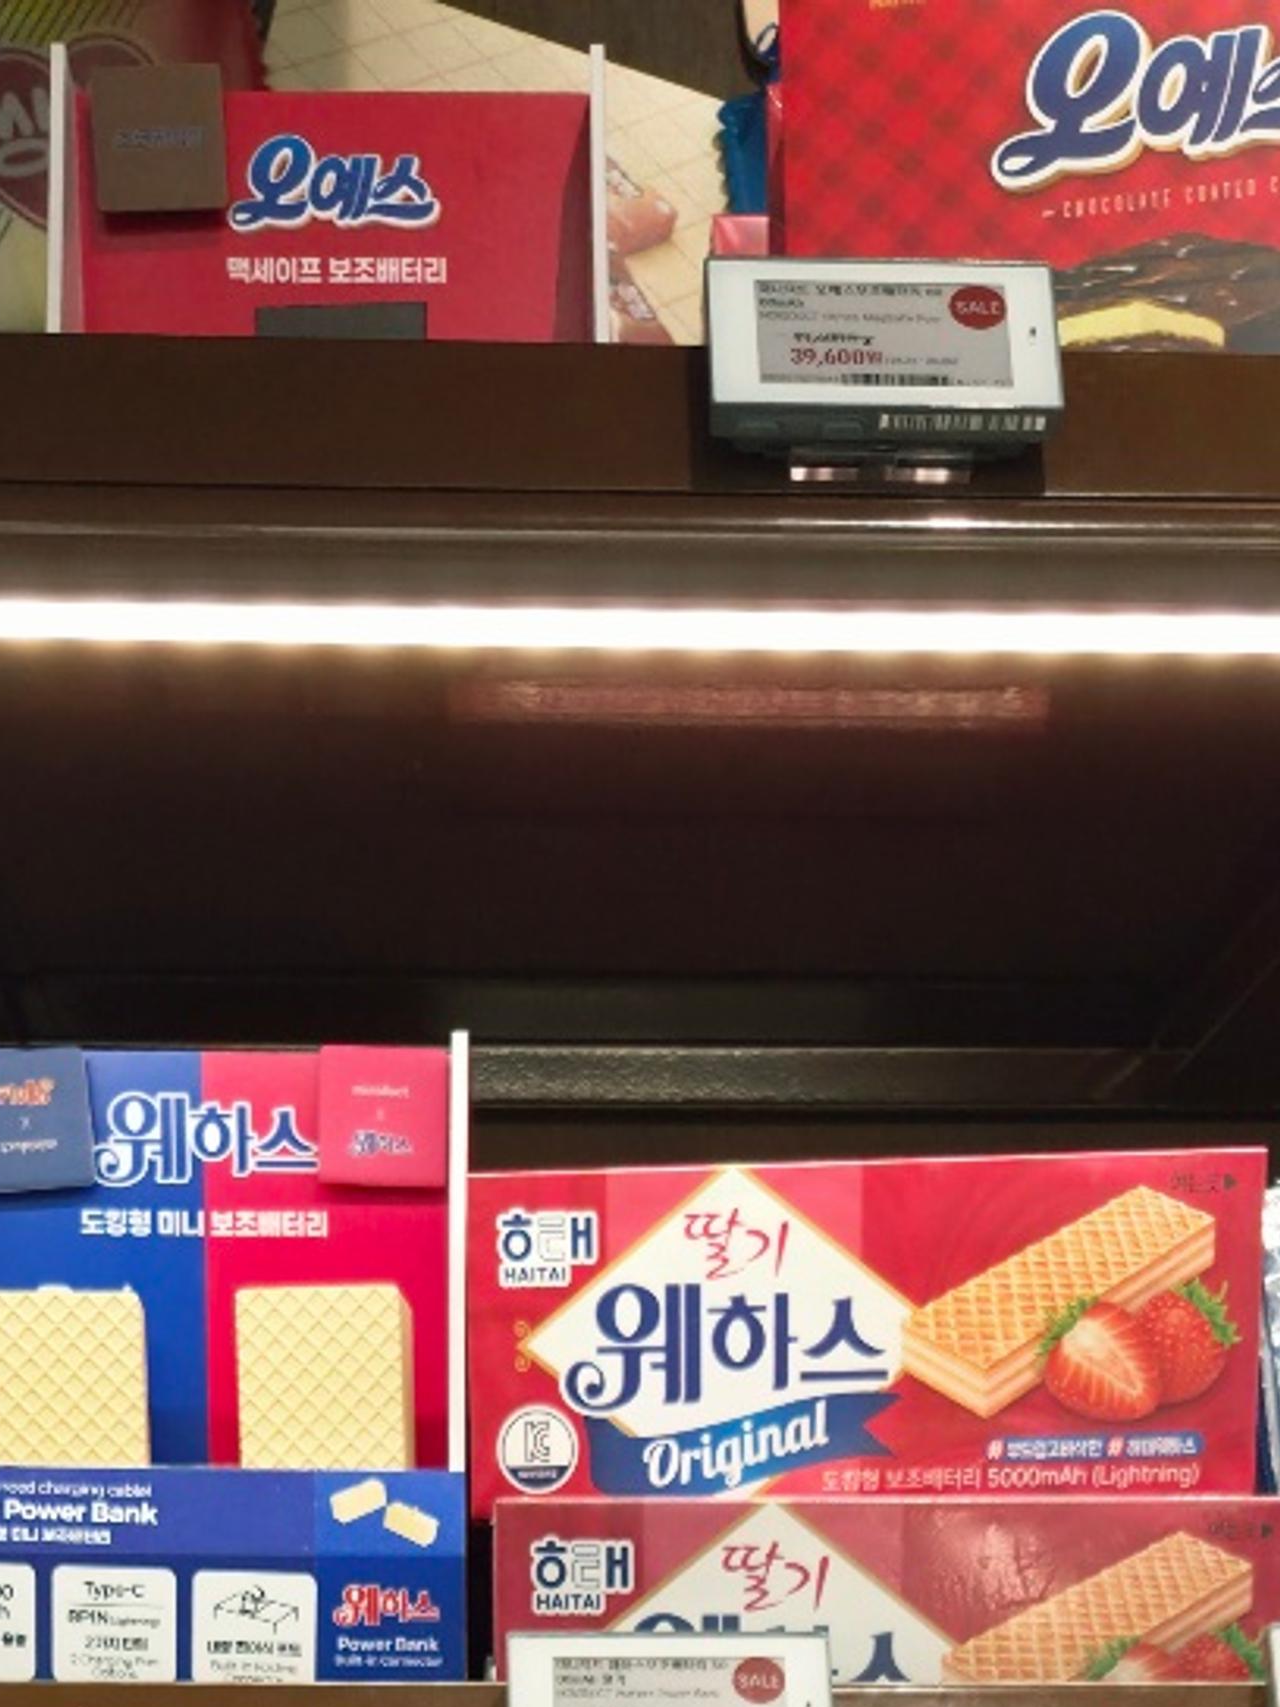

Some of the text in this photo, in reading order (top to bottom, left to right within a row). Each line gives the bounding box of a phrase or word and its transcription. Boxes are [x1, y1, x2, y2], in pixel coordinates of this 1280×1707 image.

[228, 134, 439, 233] 오예스
[228, 257, 447, 286] 맥세이프 보조배터리
[955, 301, 1002, 316] SALE
[93, 1091, 318, 1186] 웨하스
[158, 1210, 204, 1237] 미니
[210, 1209, 328, 1238] 보조배터리
[498, 1211, 597, 1263] 해태
[683, 1208, 788, 1279] 딸기
[503, 1265, 568, 1284] HAITAI
[565, 1284, 889, 1412] 웨하스
[644, 1410, 829, 1489] Original
[988, 1467, 1087, 1488] 5000mAh
[1091, 1464, 1200, 1490] (Lightning)
[5, 1498, 88, 1523] Power
[92, 1501, 159, 1527] Bank
[533, 1541, 634, 1593] 해태
[723, 1540, 831, 1612] 딸기
[333, 1584, 441, 1627] 웨하스
[535, 1595, 601, 1613] HAITAI
[337, 1636, 441, 1654] Power Bank
[739, 1673, 781, 1688] SALE
